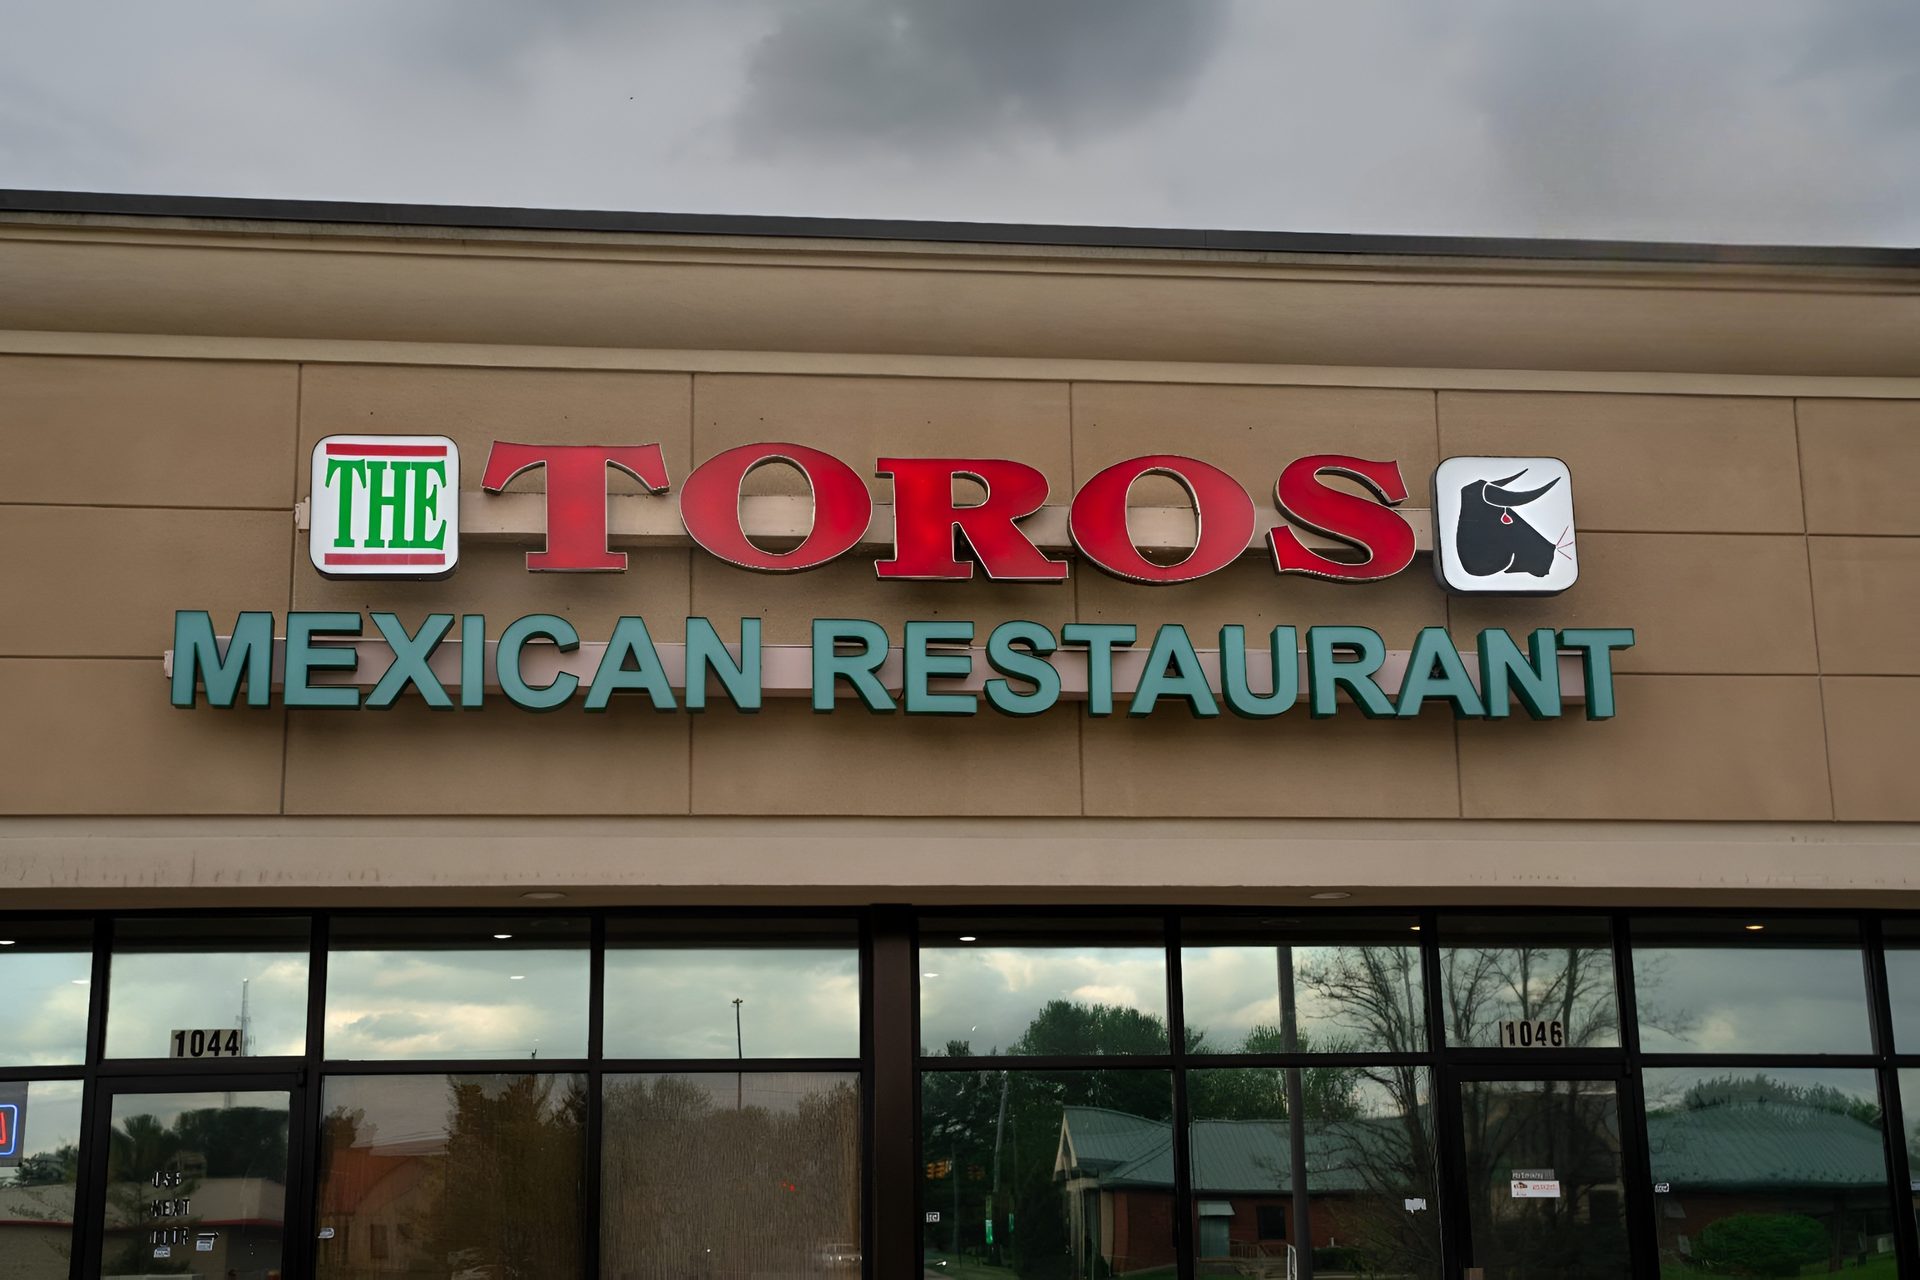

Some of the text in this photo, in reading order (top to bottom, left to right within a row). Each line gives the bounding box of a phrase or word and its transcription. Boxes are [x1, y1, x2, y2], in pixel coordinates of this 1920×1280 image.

[325, 440, 1416, 585] THE TOROS
[170, 610, 1635, 721] MEXICAN RESTAURANT
[175, 1029, 239, 1057] 1044
[1505, 1021, 1562, 1047] 1046
[151, 1197, 190, 1217] NEXT
